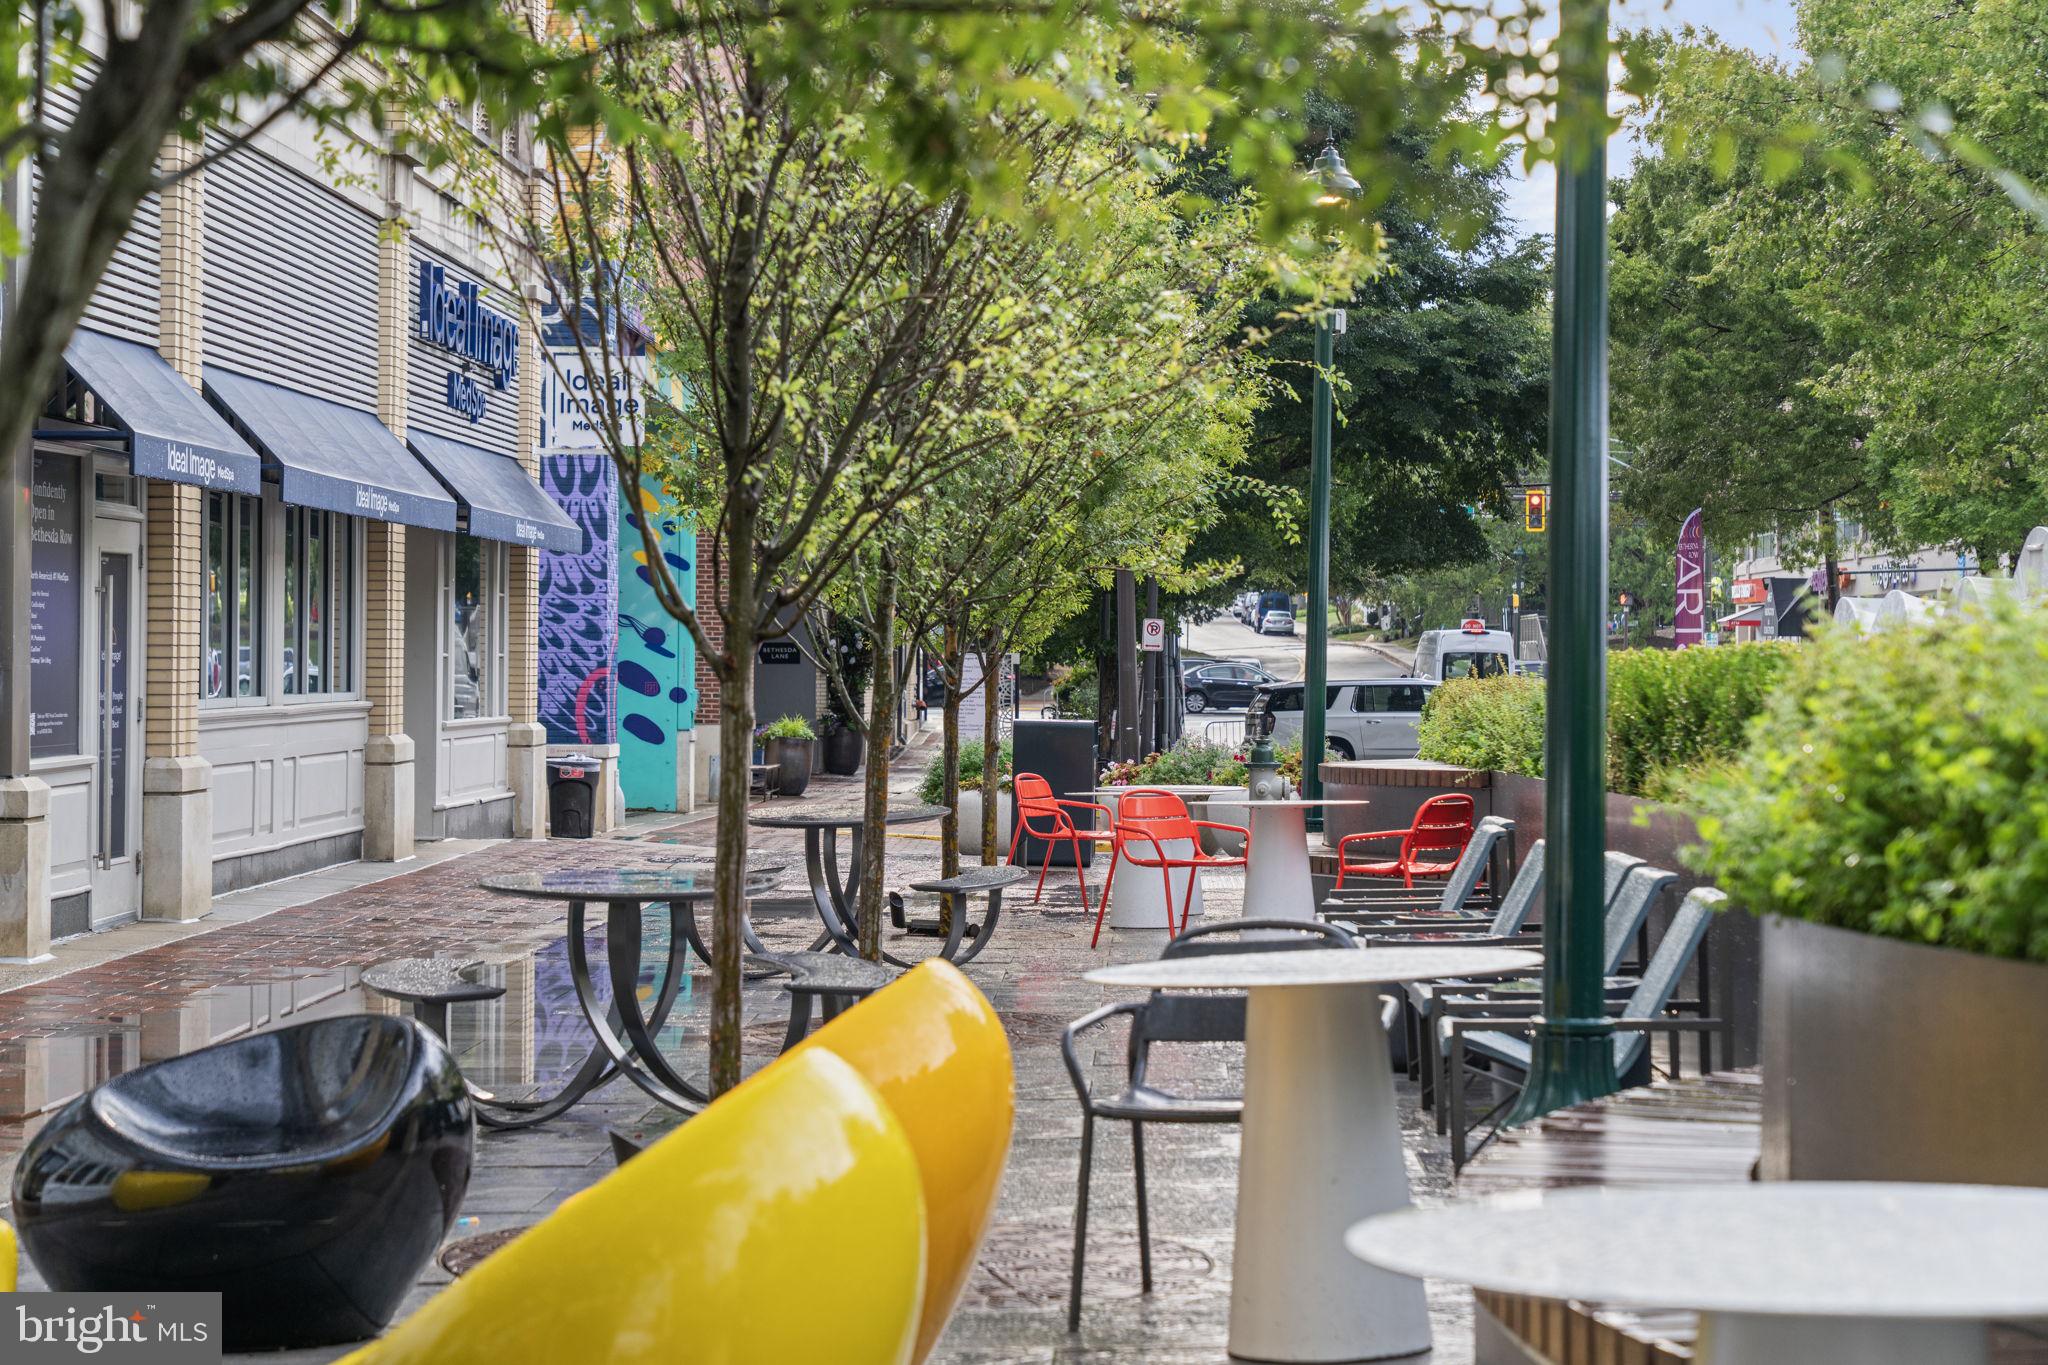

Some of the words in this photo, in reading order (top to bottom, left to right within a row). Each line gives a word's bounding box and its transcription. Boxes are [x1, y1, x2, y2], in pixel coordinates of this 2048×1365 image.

[420, 261, 471, 356] Ideal
[471, 284, 519, 390] Image
[566, 368, 627, 391] Ideal
[448, 373, 487, 423] MedSpa
[560, 392, 639, 418] Image
[572, 420, 623, 431] MedSa
[167, 443, 188, 473] Ideal
[189, 447, 215, 485] Image
[217, 465, 234, 482] MedSpa
[32, 481, 66, 502] onfidently
[356, 484, 370, 508] Ideal
[371, 487, 387, 517] Image
[47, 504, 54, 520] in
[59, 529, 72, 544] Row
